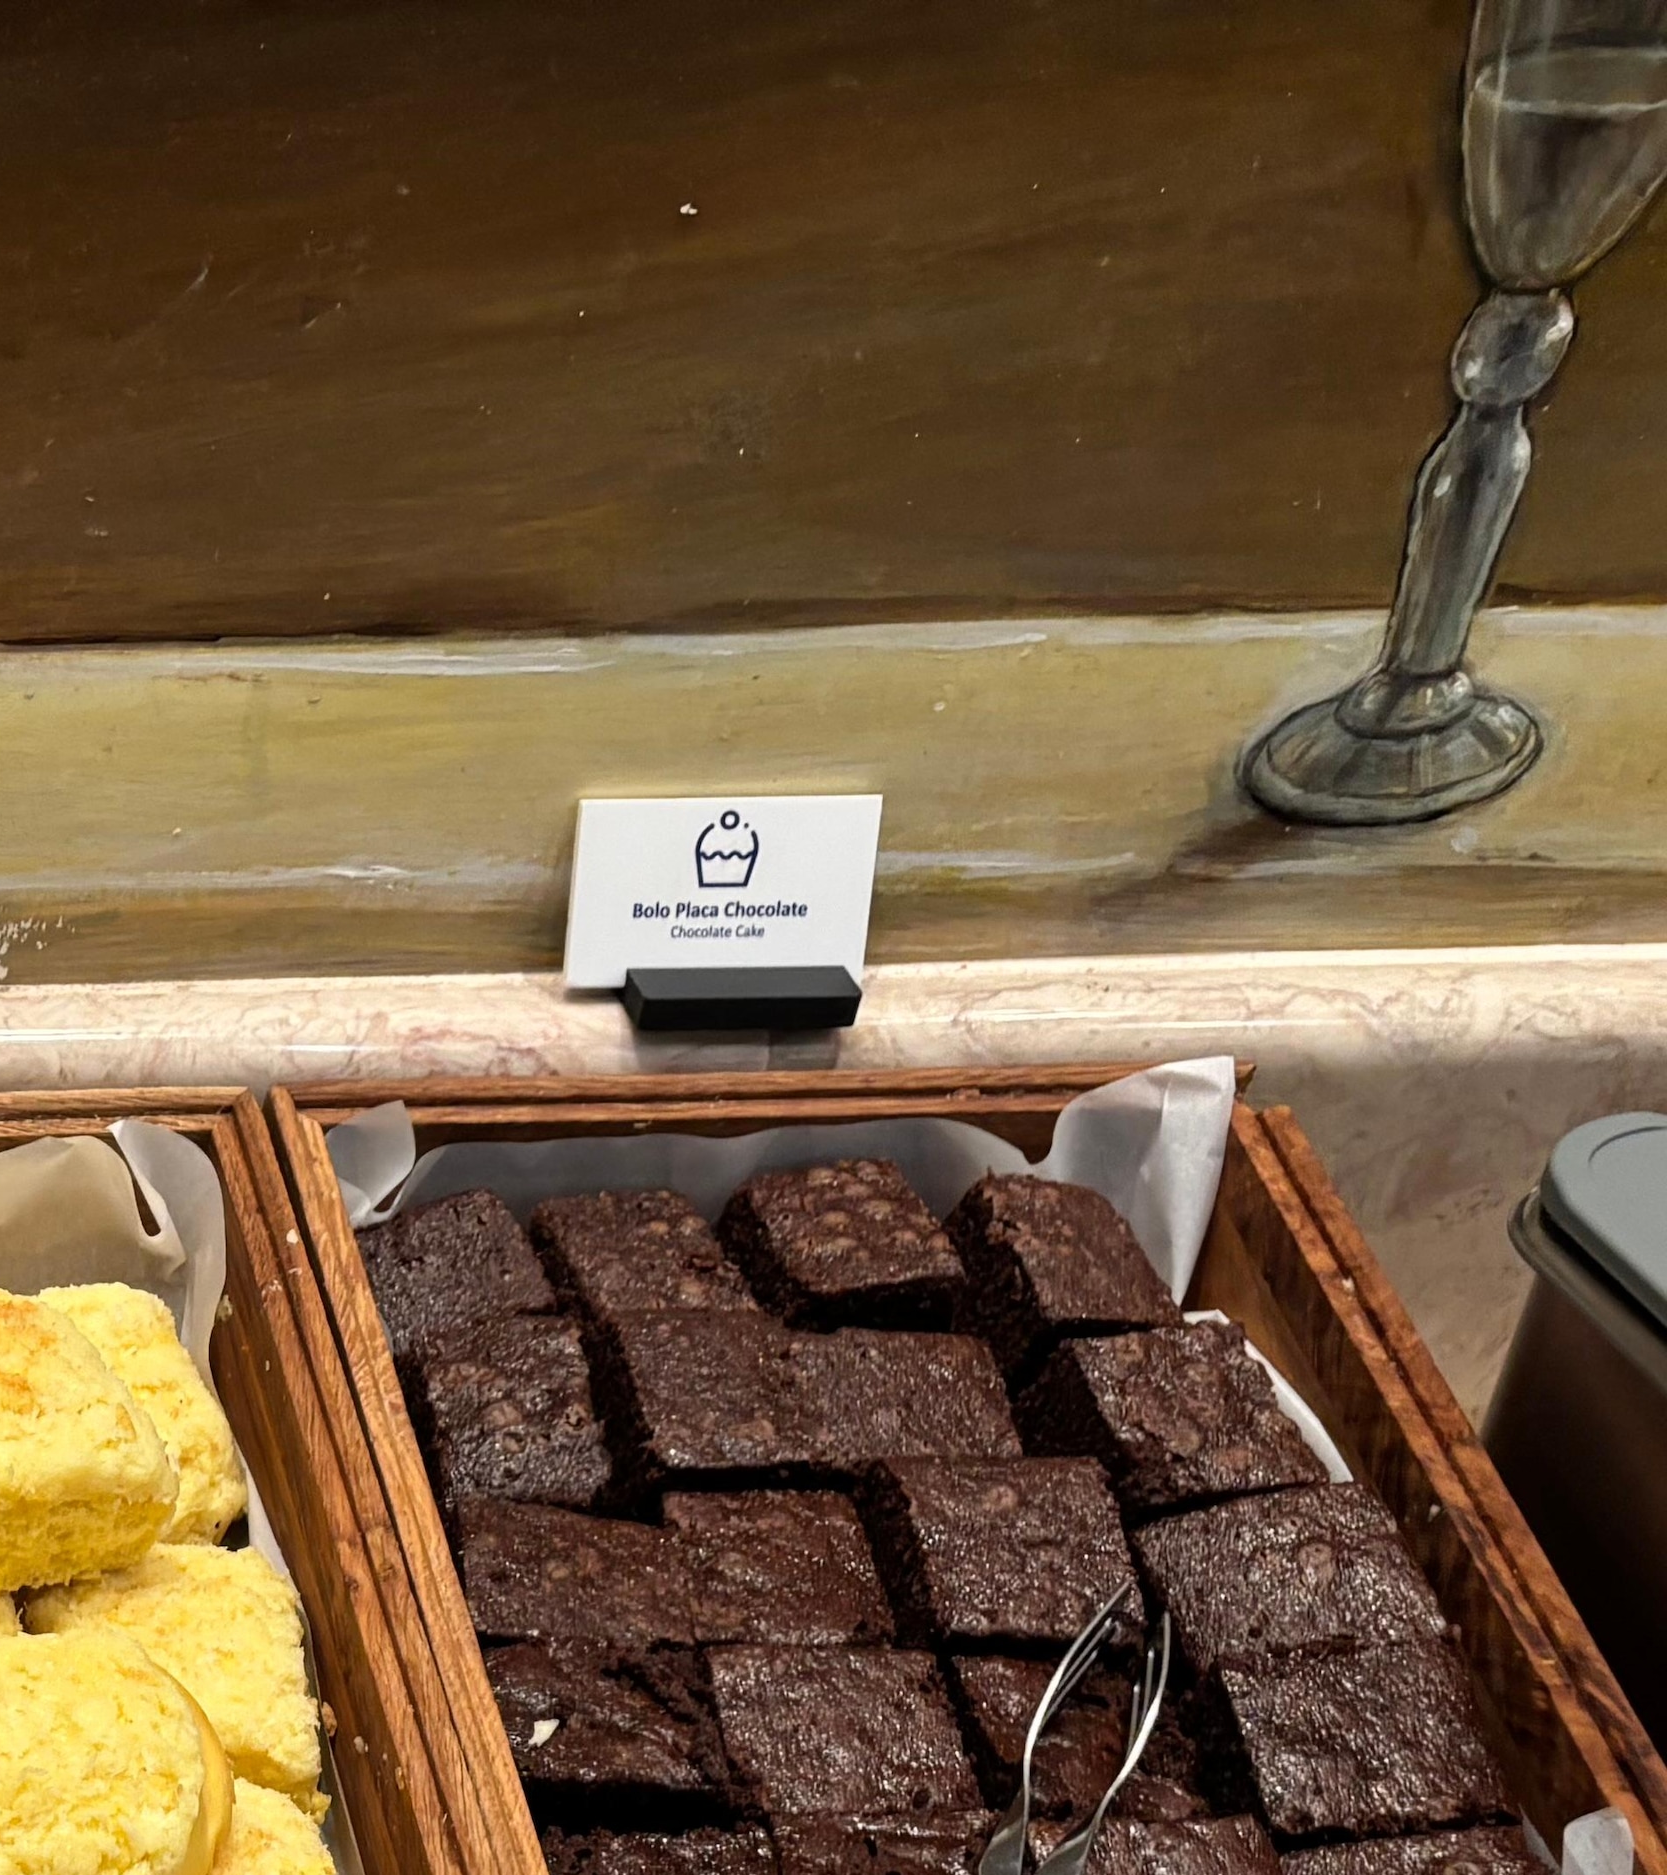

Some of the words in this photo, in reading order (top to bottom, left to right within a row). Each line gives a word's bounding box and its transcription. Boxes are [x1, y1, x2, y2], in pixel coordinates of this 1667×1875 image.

[632, 901, 671, 919] Bolo
[675, 901, 719, 919] Placa
[723, 900, 808, 918] Chocolate
[670, 924, 733, 939] Chocolate
[735, 924, 765, 938] Cake
